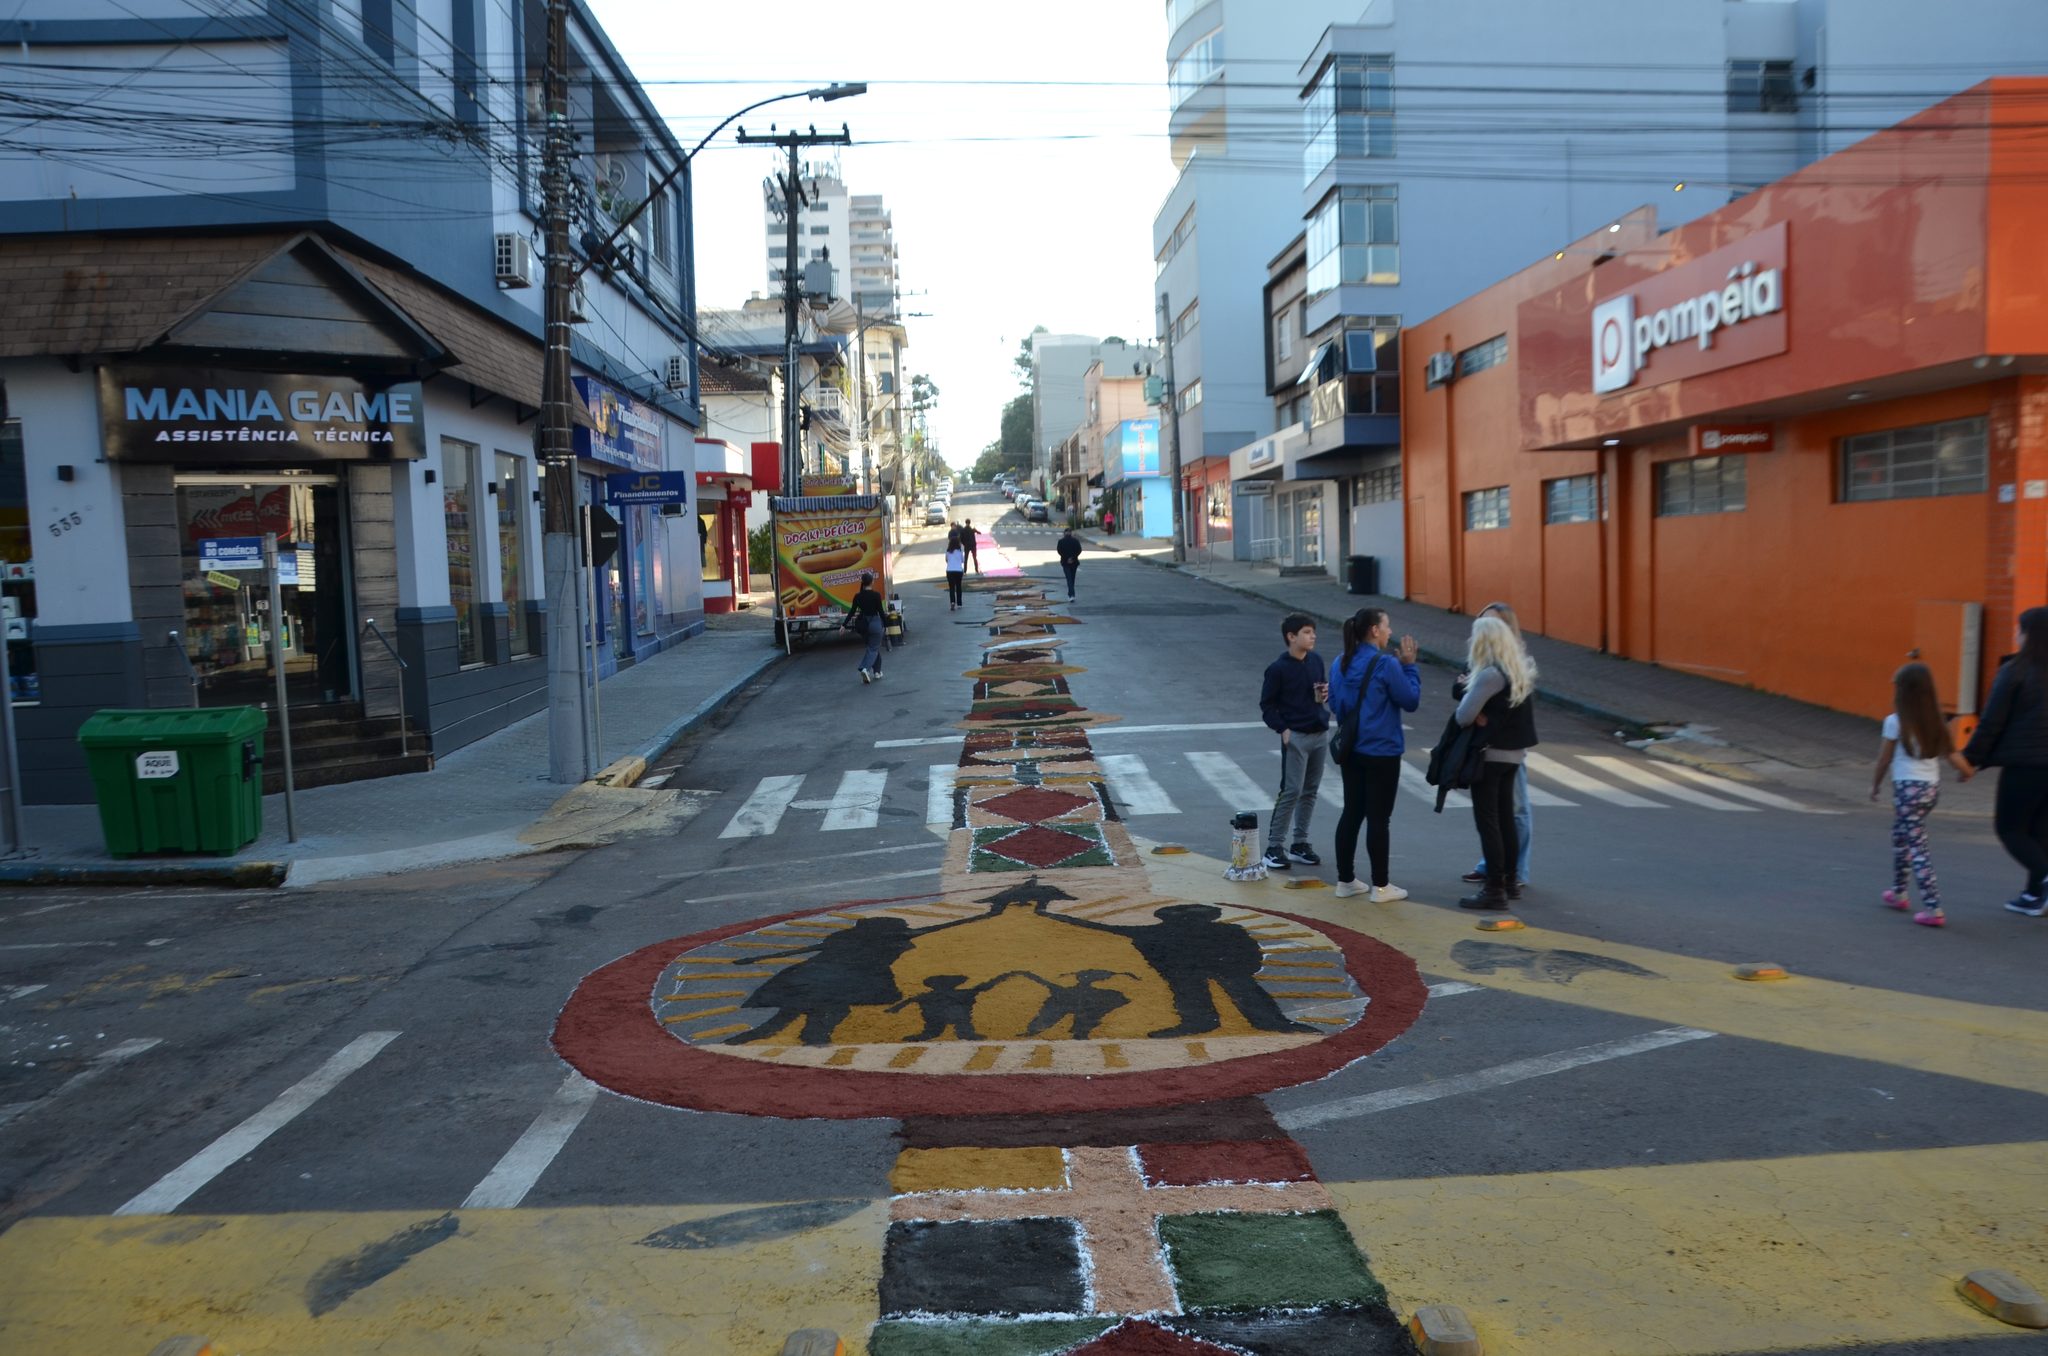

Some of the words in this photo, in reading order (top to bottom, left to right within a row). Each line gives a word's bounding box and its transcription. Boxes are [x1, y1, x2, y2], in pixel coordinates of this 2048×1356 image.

[1633, 260, 1782, 370] pompéia
[124, 387, 284, 421] MANIA
[290, 390, 415, 423] GAME
[155, 427, 299, 442] ASSISTÊNCIA
[313, 428, 395, 443] TÉCNICA
[630, 475, 661, 490] JC
[613, 490, 679, 499] Financiamentos
[784, 532, 808, 546] DOG
[823, 520, 866, 538] DELÍCIA
[218, 544, 258, 556] COMÉRCIO
